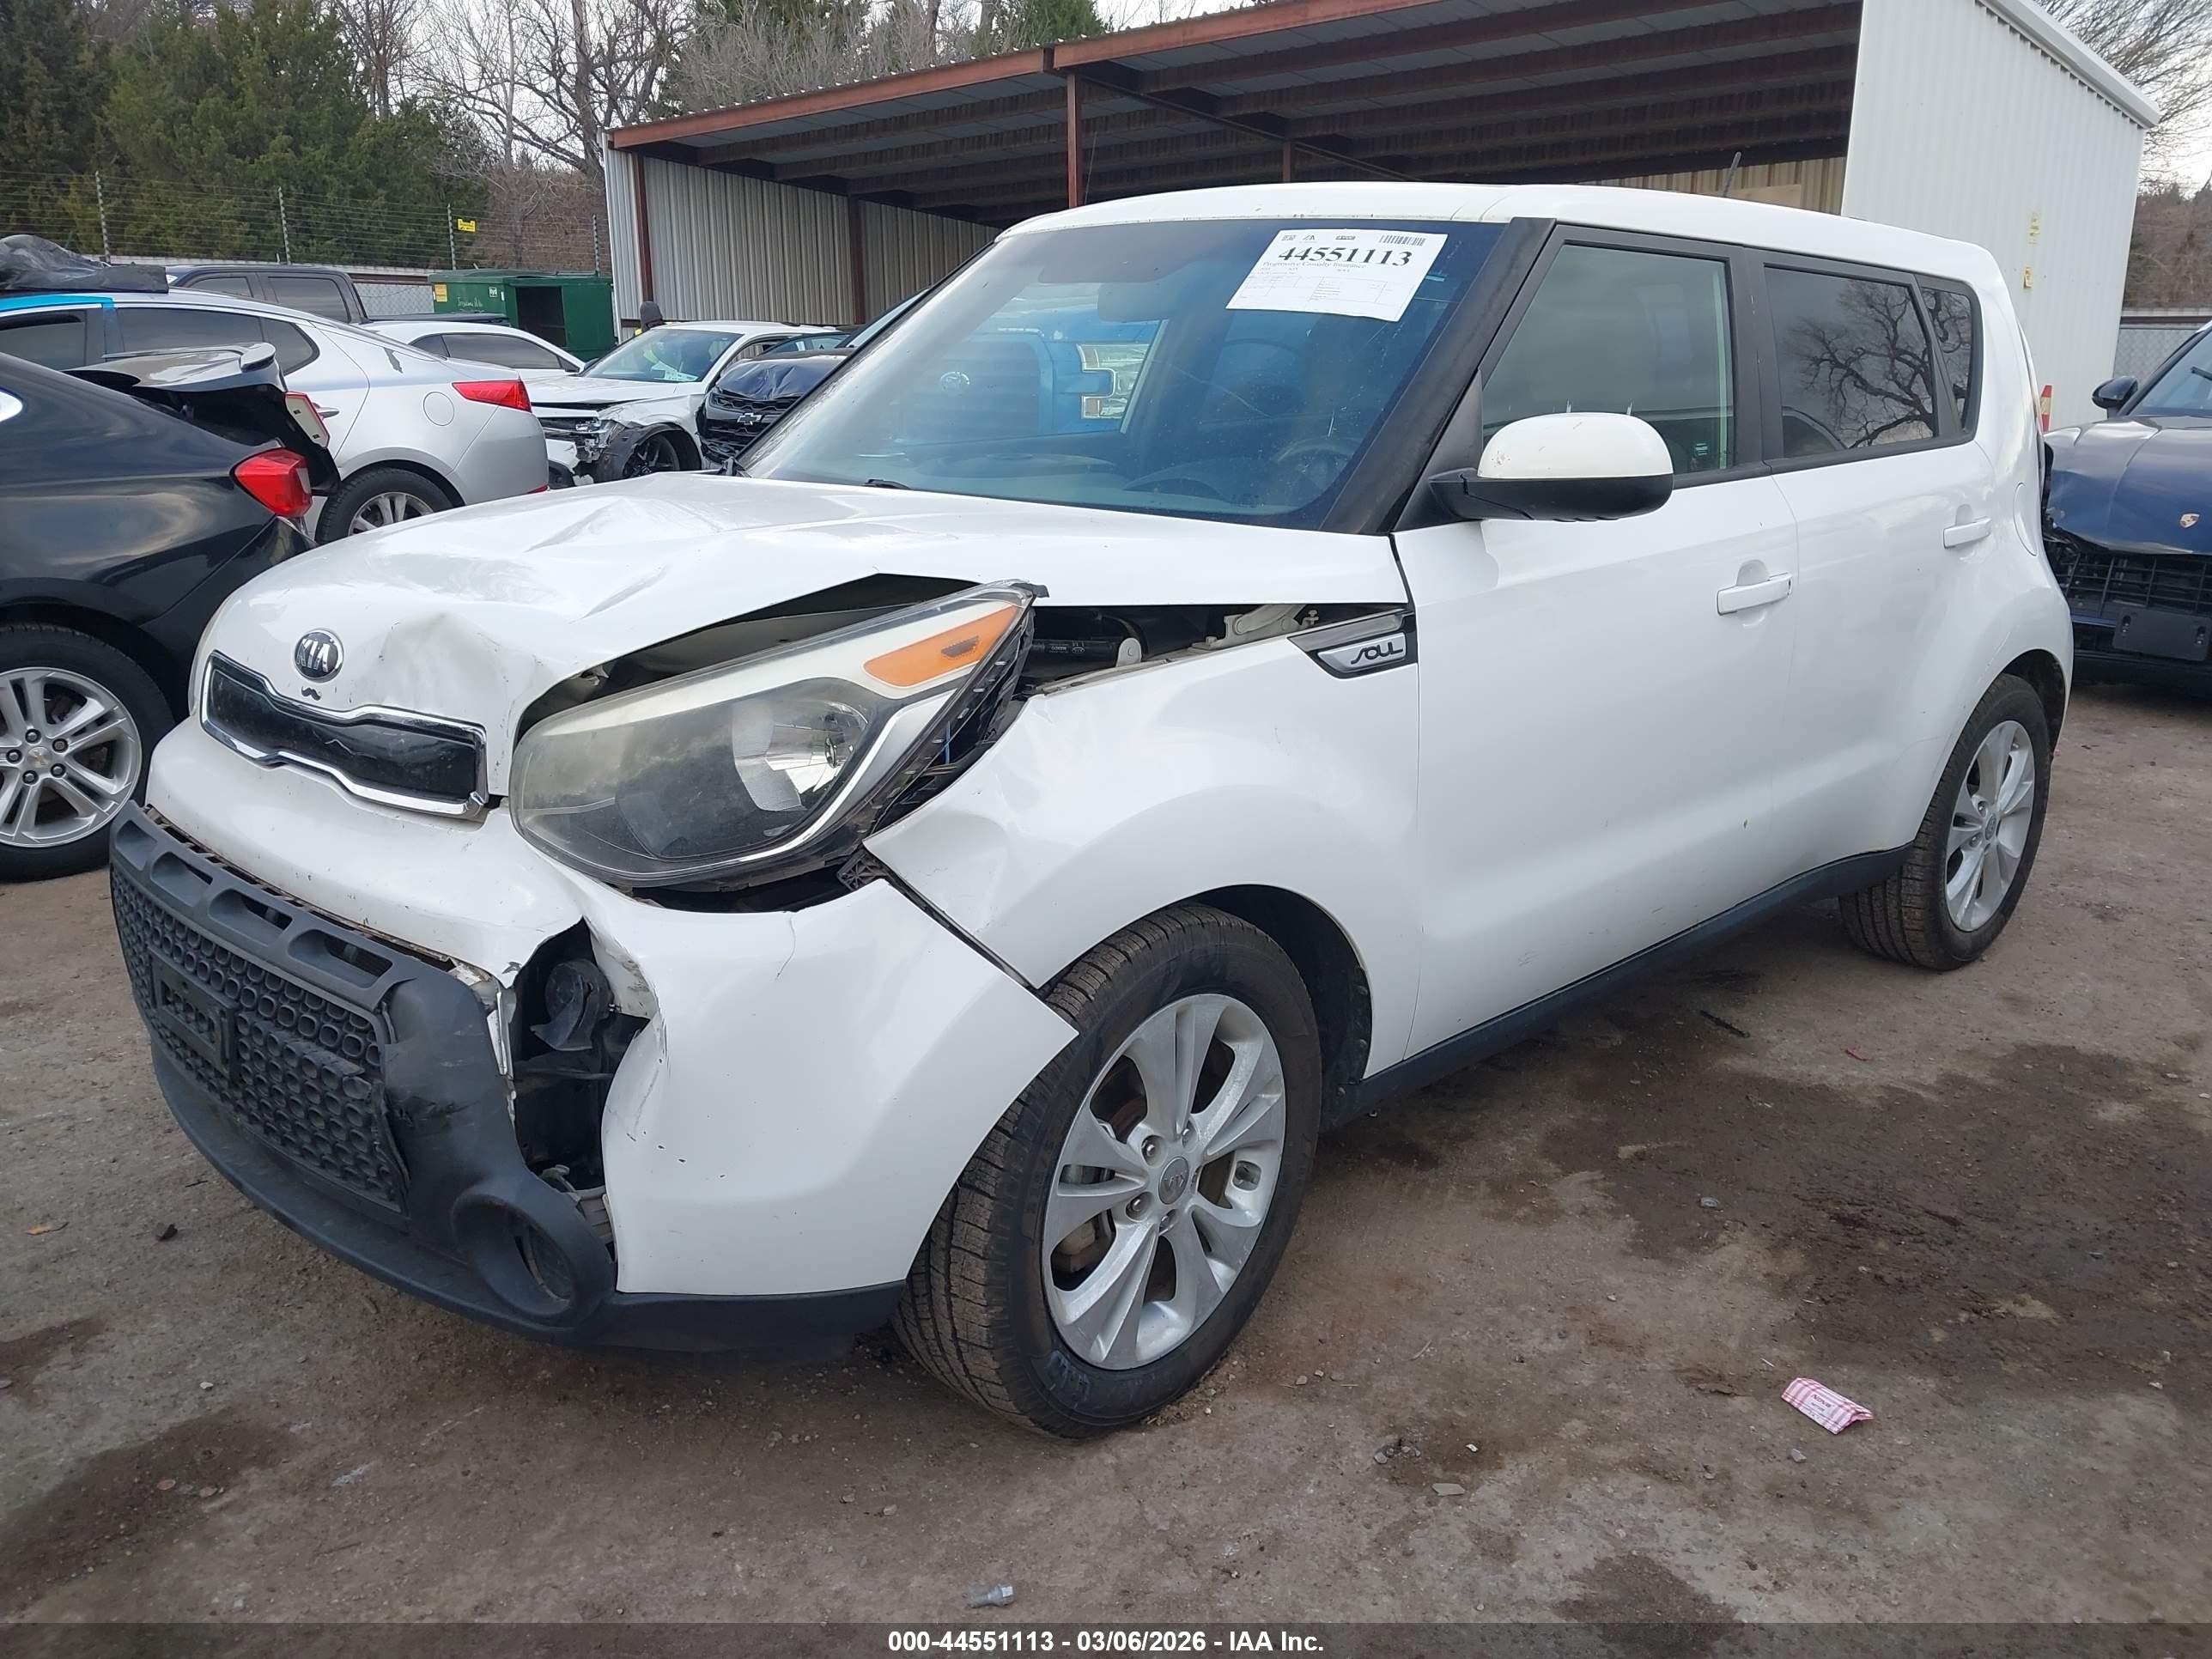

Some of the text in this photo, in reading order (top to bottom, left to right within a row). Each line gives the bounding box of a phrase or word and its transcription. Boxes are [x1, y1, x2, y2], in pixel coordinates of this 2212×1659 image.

[1278, 246, 1413, 266] 44551113
[295, 636, 330, 672] KIA
[1351, 641, 1404, 665] SOUL
